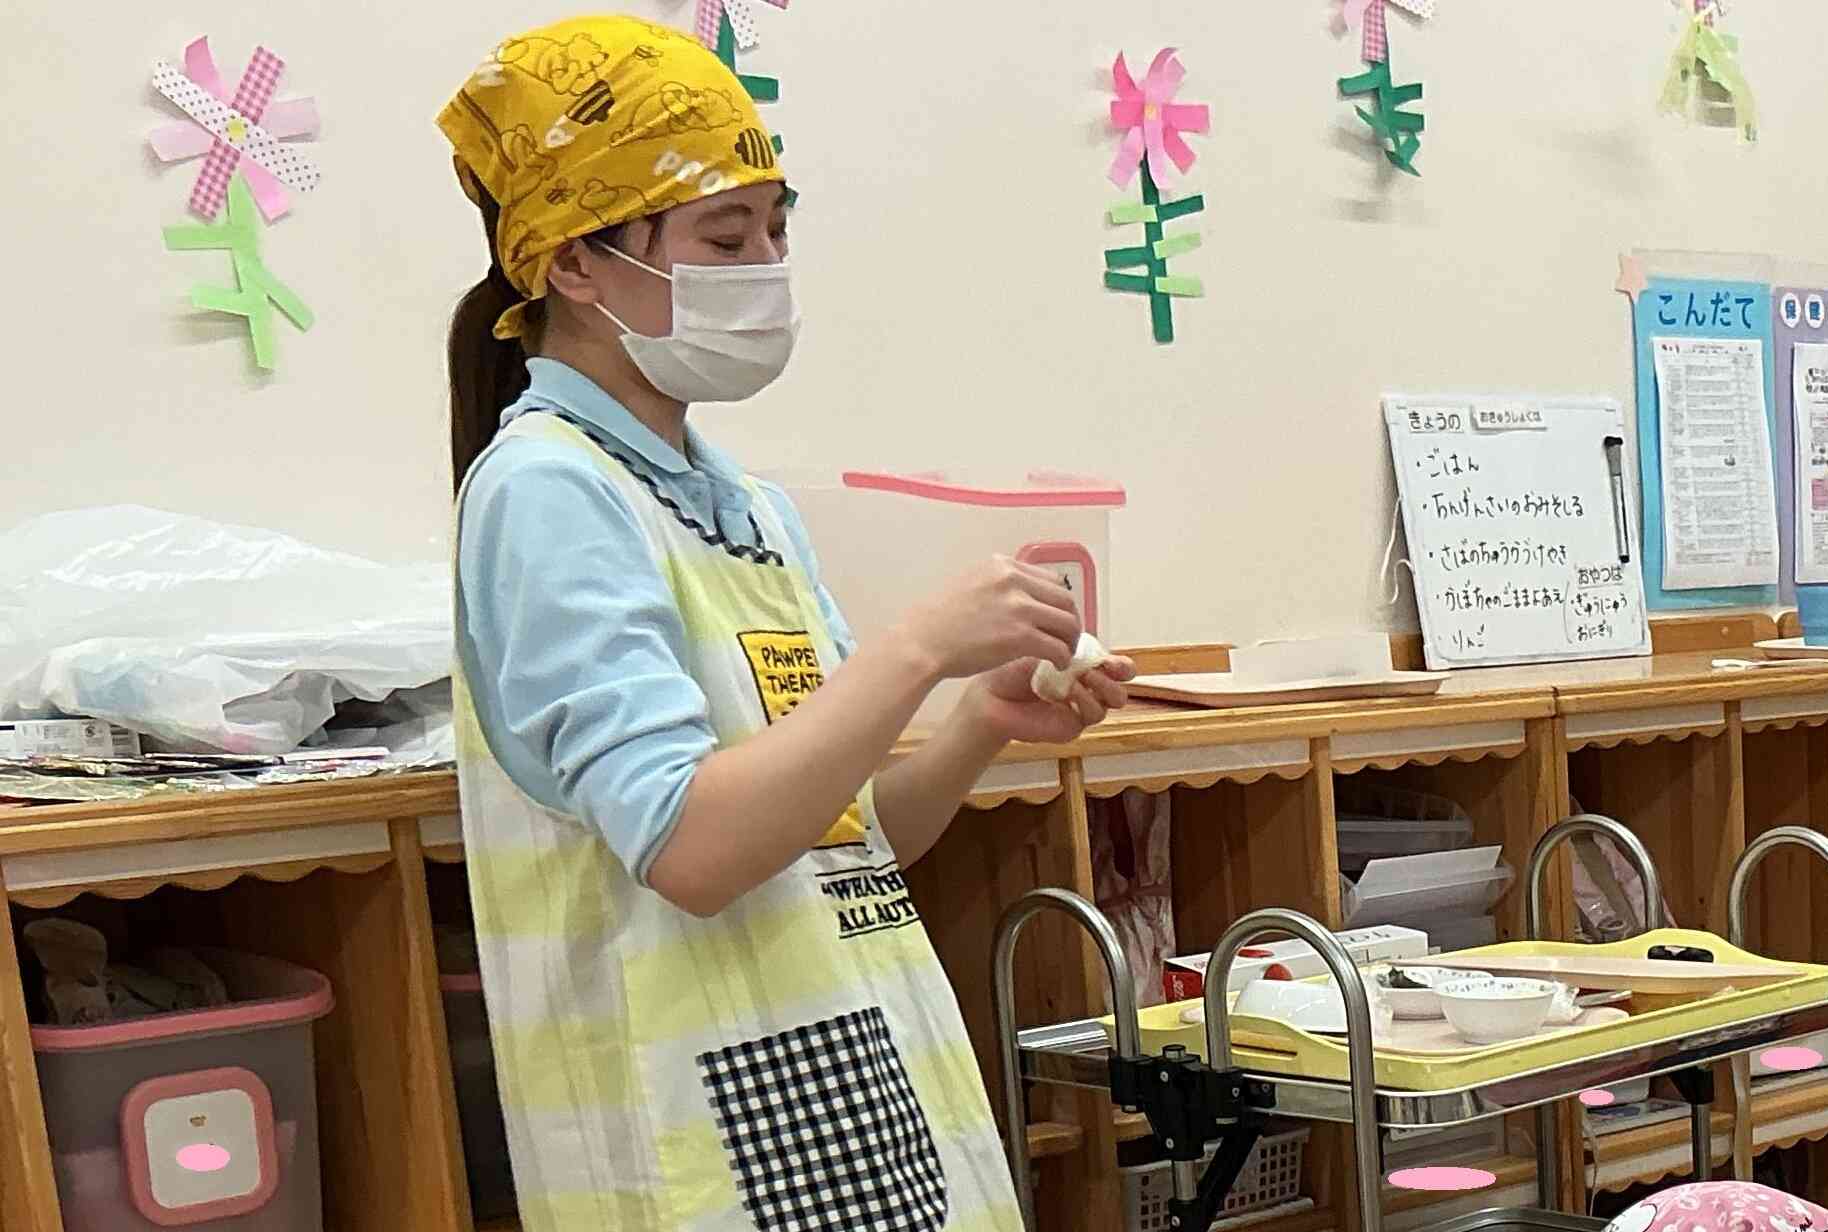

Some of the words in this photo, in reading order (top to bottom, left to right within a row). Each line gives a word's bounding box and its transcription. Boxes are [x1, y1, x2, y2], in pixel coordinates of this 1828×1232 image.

[1657, 292, 1754, 329] こんだて
[1408, 411, 1461, 430] きょうの
[1427, 448, 1479, 477] ごはん
[1577, 566, 1624, 585] おやつは
[1452, 623, 1485, 652] りんご
